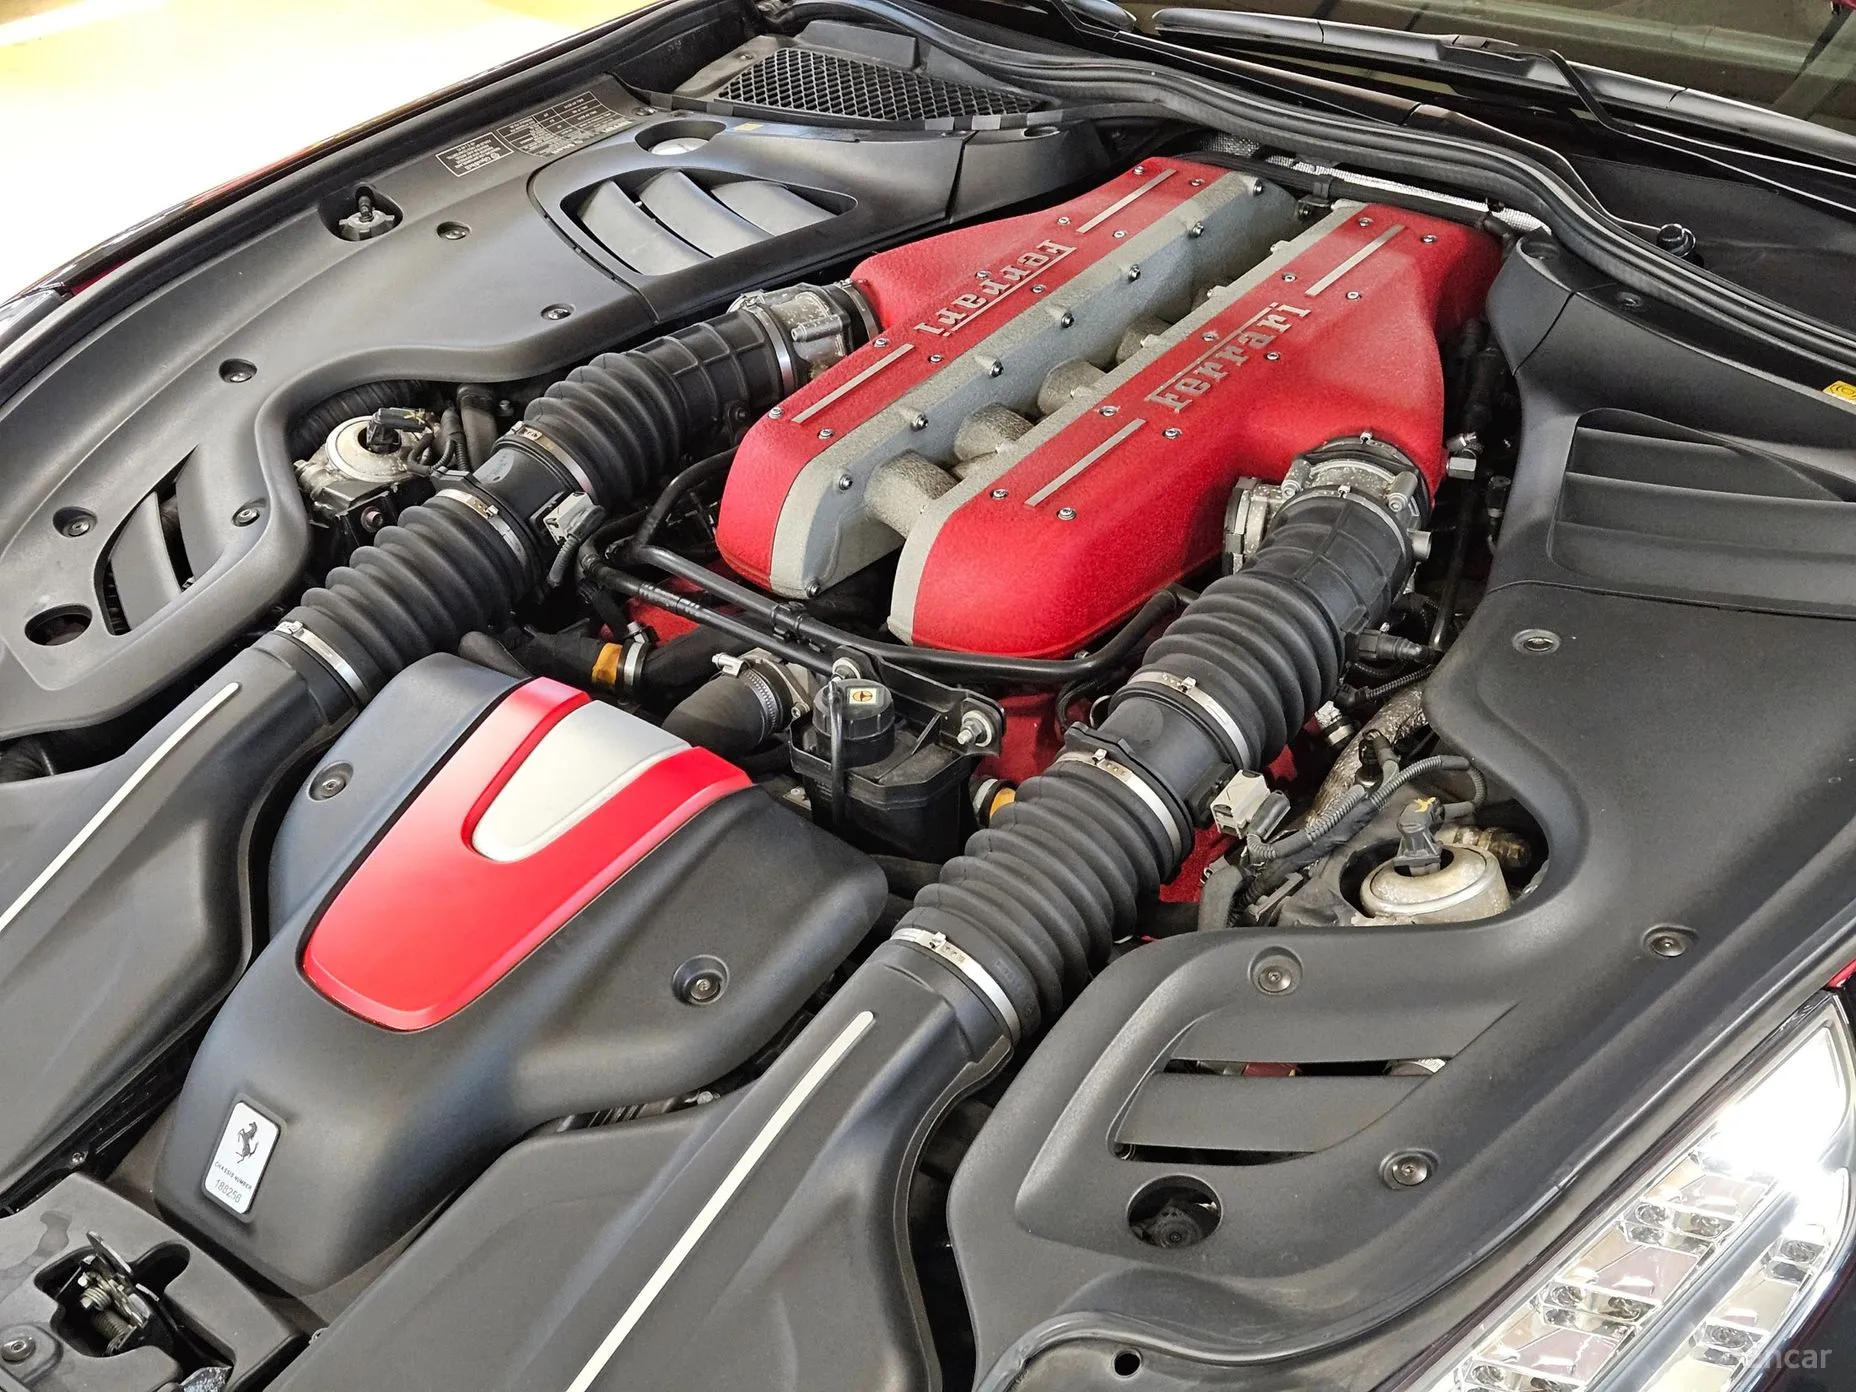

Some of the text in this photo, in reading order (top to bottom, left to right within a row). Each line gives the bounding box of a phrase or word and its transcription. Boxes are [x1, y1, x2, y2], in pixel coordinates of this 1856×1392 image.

[913, 239, 1077, 337] Ferrari
[1144, 302, 1312, 413] Ferrari
[214, 1161, 253, 1191] CHASSIS NUMBER
